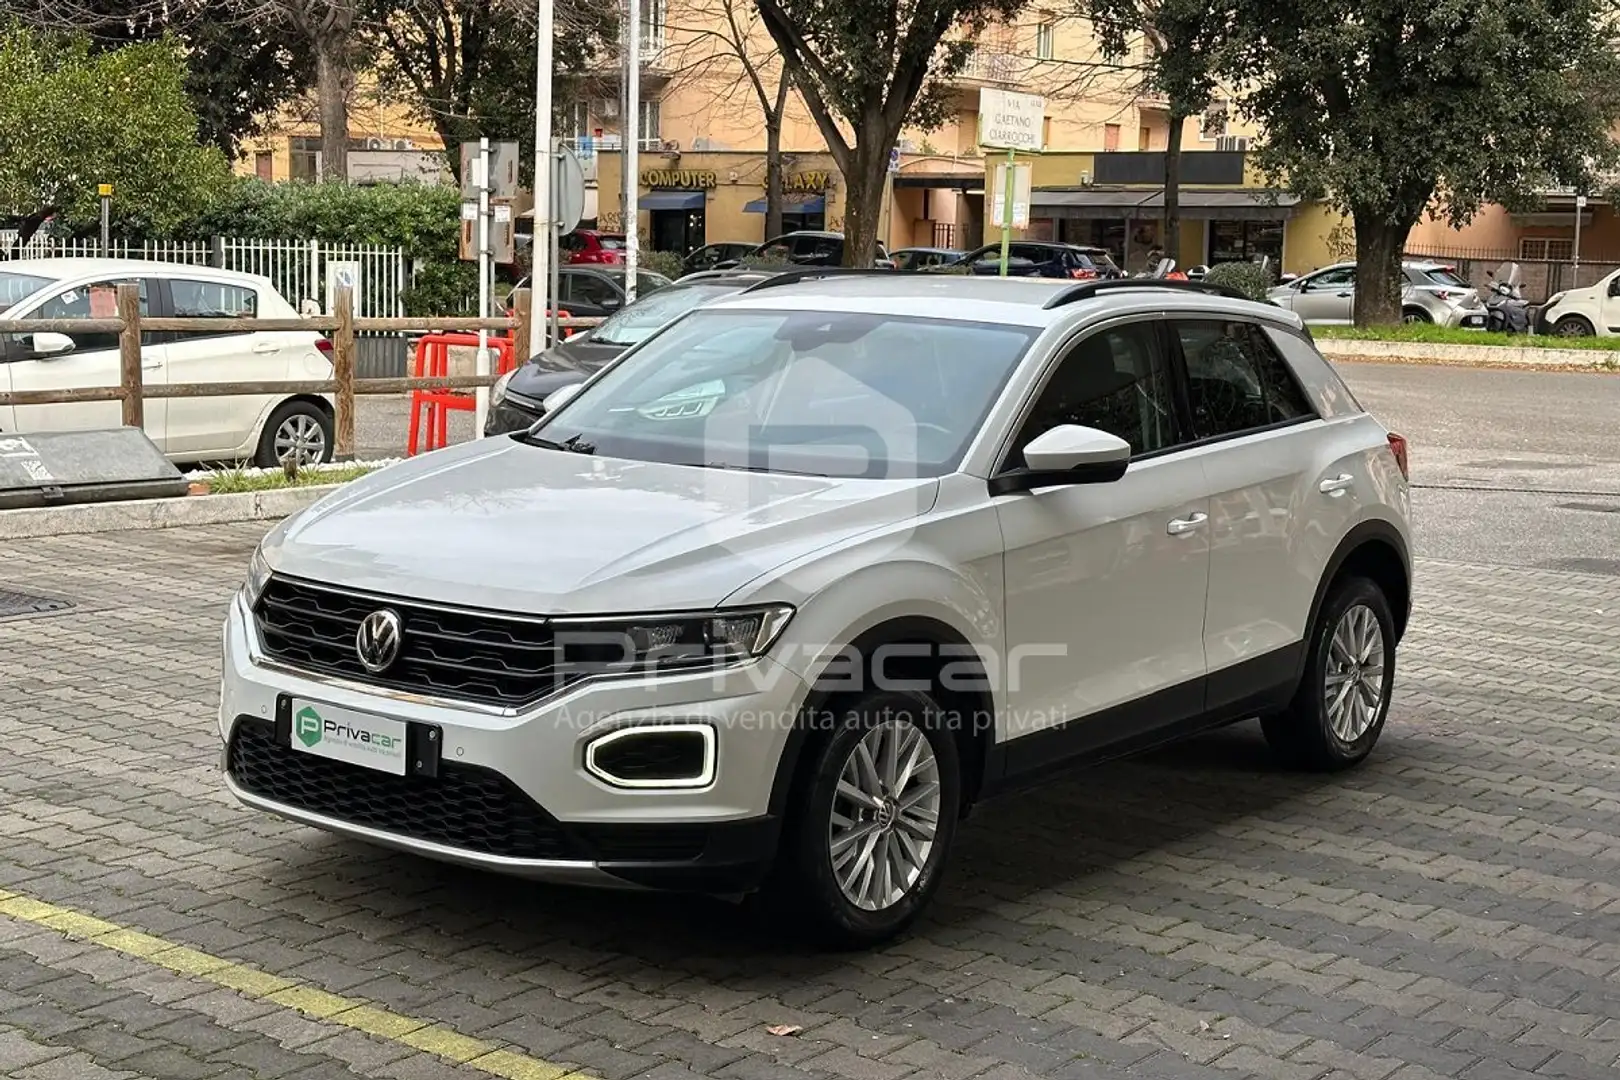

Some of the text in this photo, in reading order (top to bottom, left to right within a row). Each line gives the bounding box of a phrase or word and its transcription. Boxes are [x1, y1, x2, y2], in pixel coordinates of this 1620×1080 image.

[1007, 99, 1020, 110] VIA
[995, 113, 1031, 127] GAETANO
[641, 170, 717, 188] COMPUTER
[324, 719, 402, 748] Privacar
